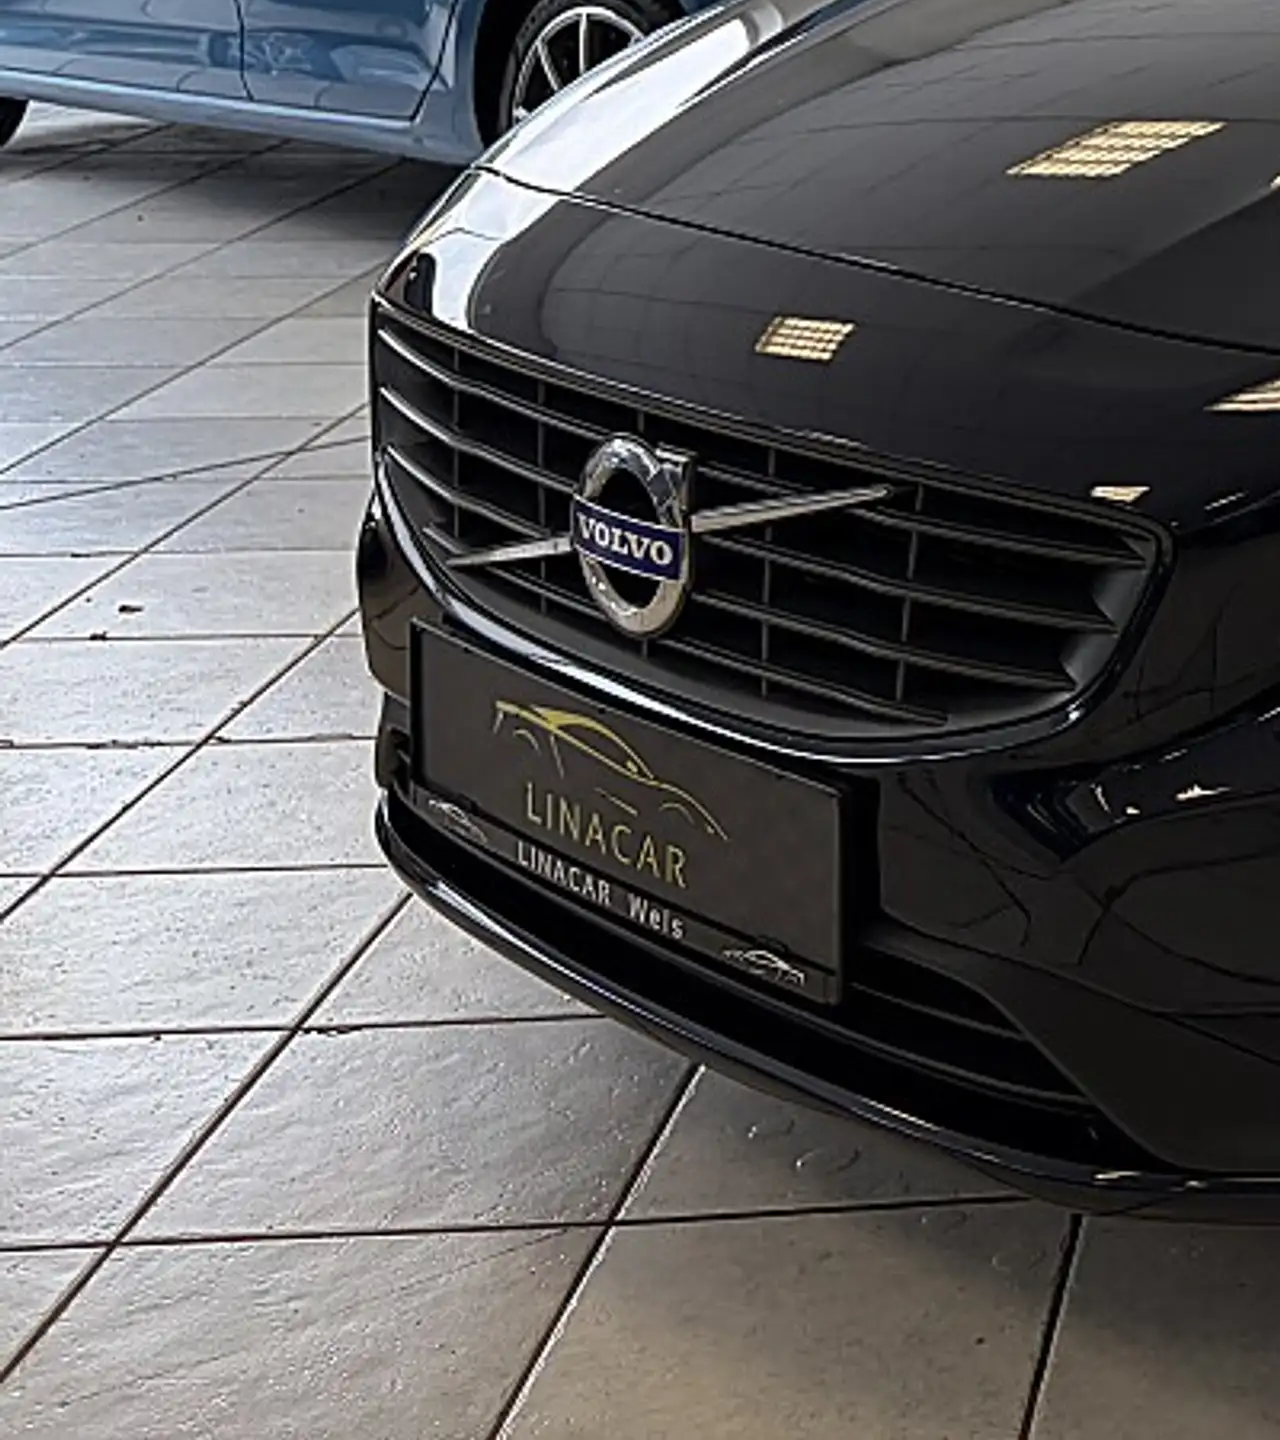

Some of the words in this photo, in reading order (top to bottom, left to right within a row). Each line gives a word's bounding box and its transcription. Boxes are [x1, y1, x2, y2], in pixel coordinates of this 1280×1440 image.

[576, 512, 674, 566] VOLVO
[526, 781, 687, 889] LINACAR
[518, 840, 611, 907] LINACAR
[627, 892, 684, 939] Wels
